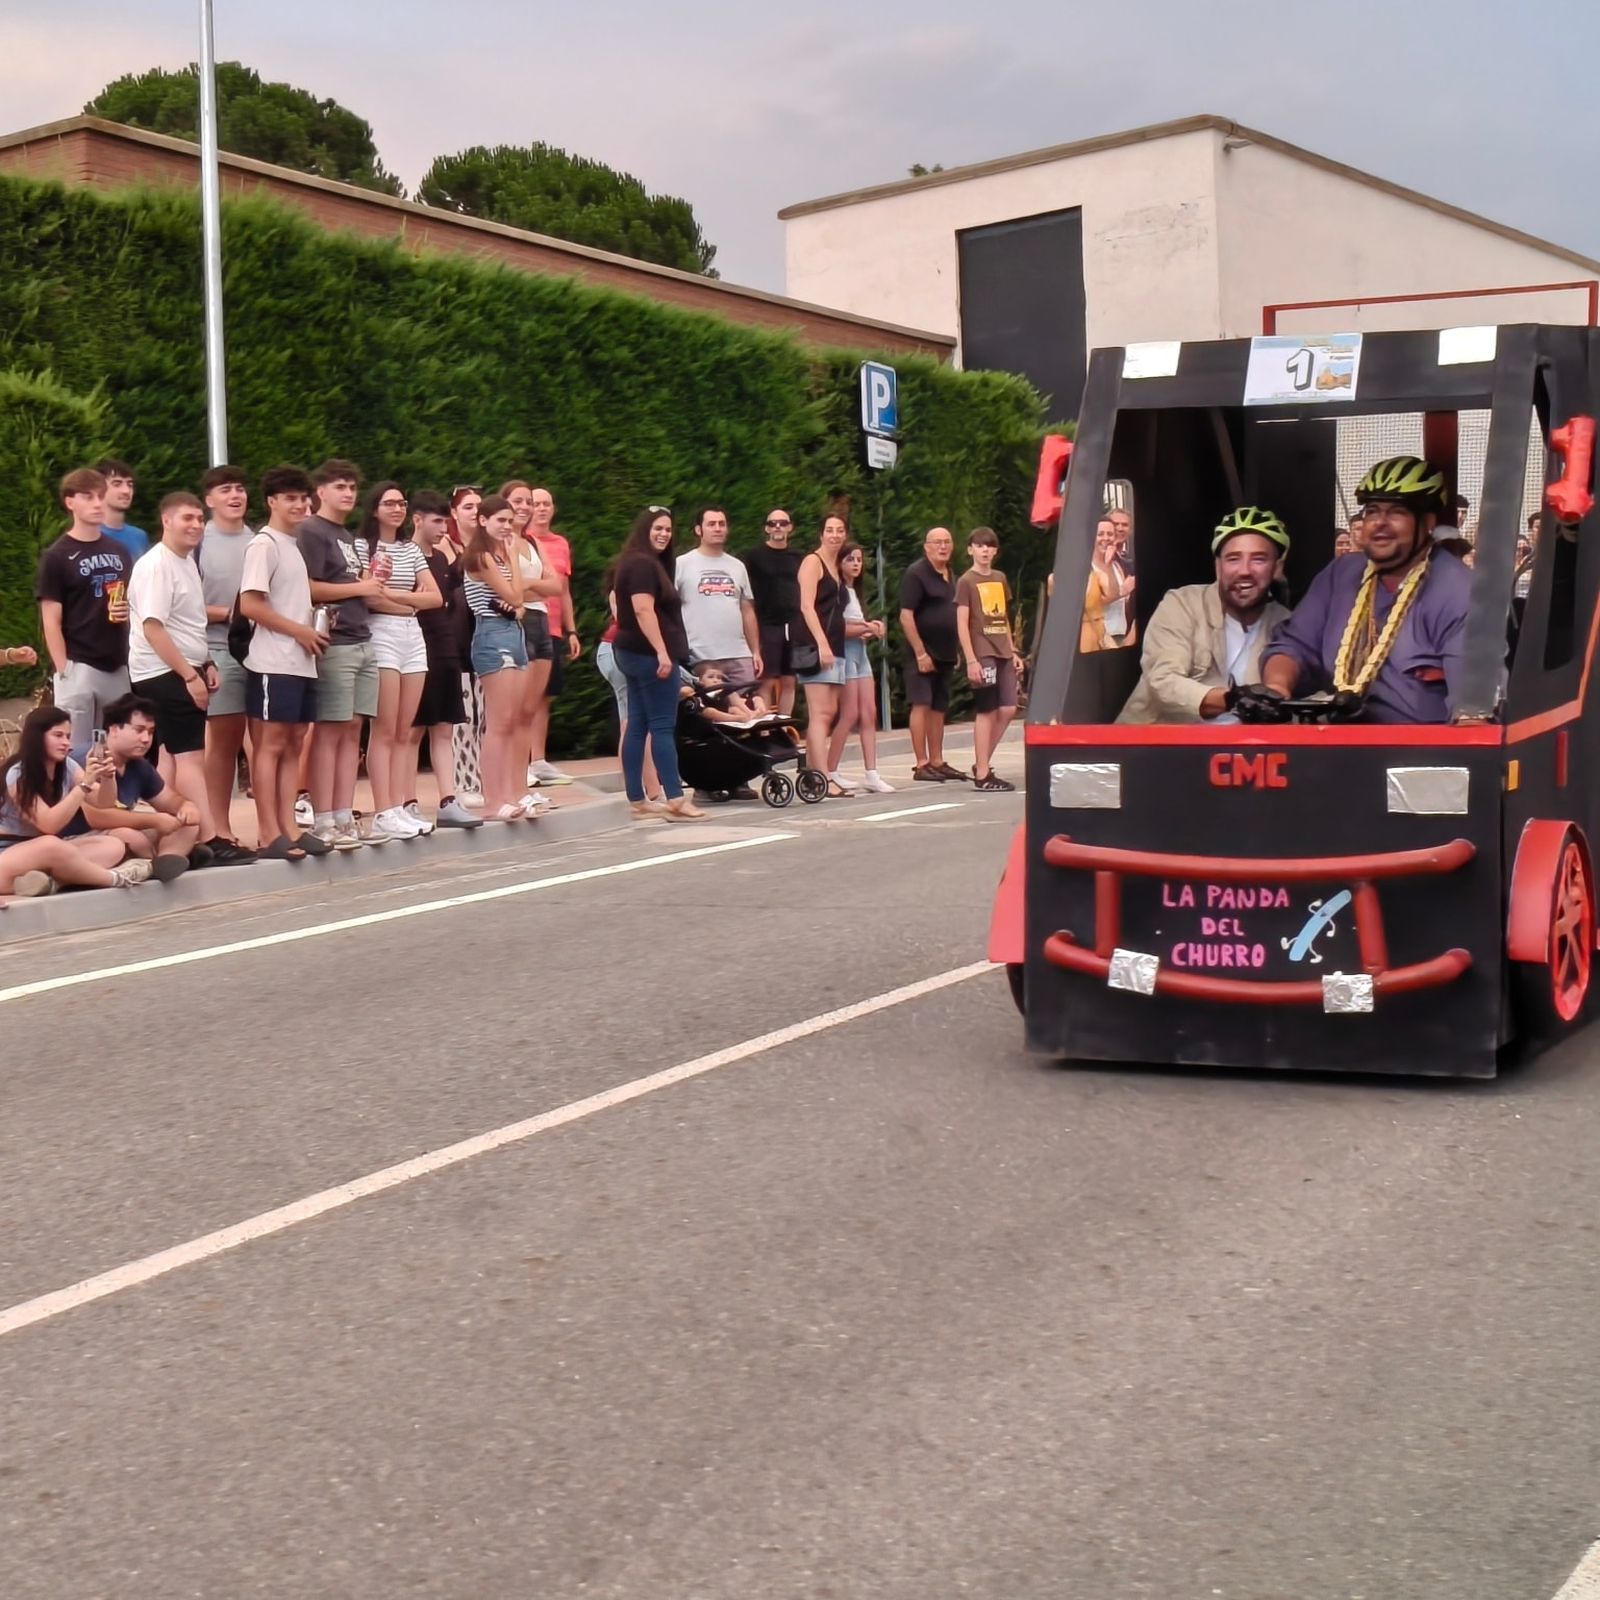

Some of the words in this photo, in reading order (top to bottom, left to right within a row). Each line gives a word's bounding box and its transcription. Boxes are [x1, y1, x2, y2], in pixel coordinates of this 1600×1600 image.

[1286, 348, 1315, 391] 1
[869, 371, 891, 429] P
[1208, 752, 1289, 789] CMC
[1161, 883, 1196, 908] LA
[1206, 884, 1290, 909] PANDA
[1200, 916, 1245, 936] DEL
[1170, 942, 1266, 968] CHURRO
